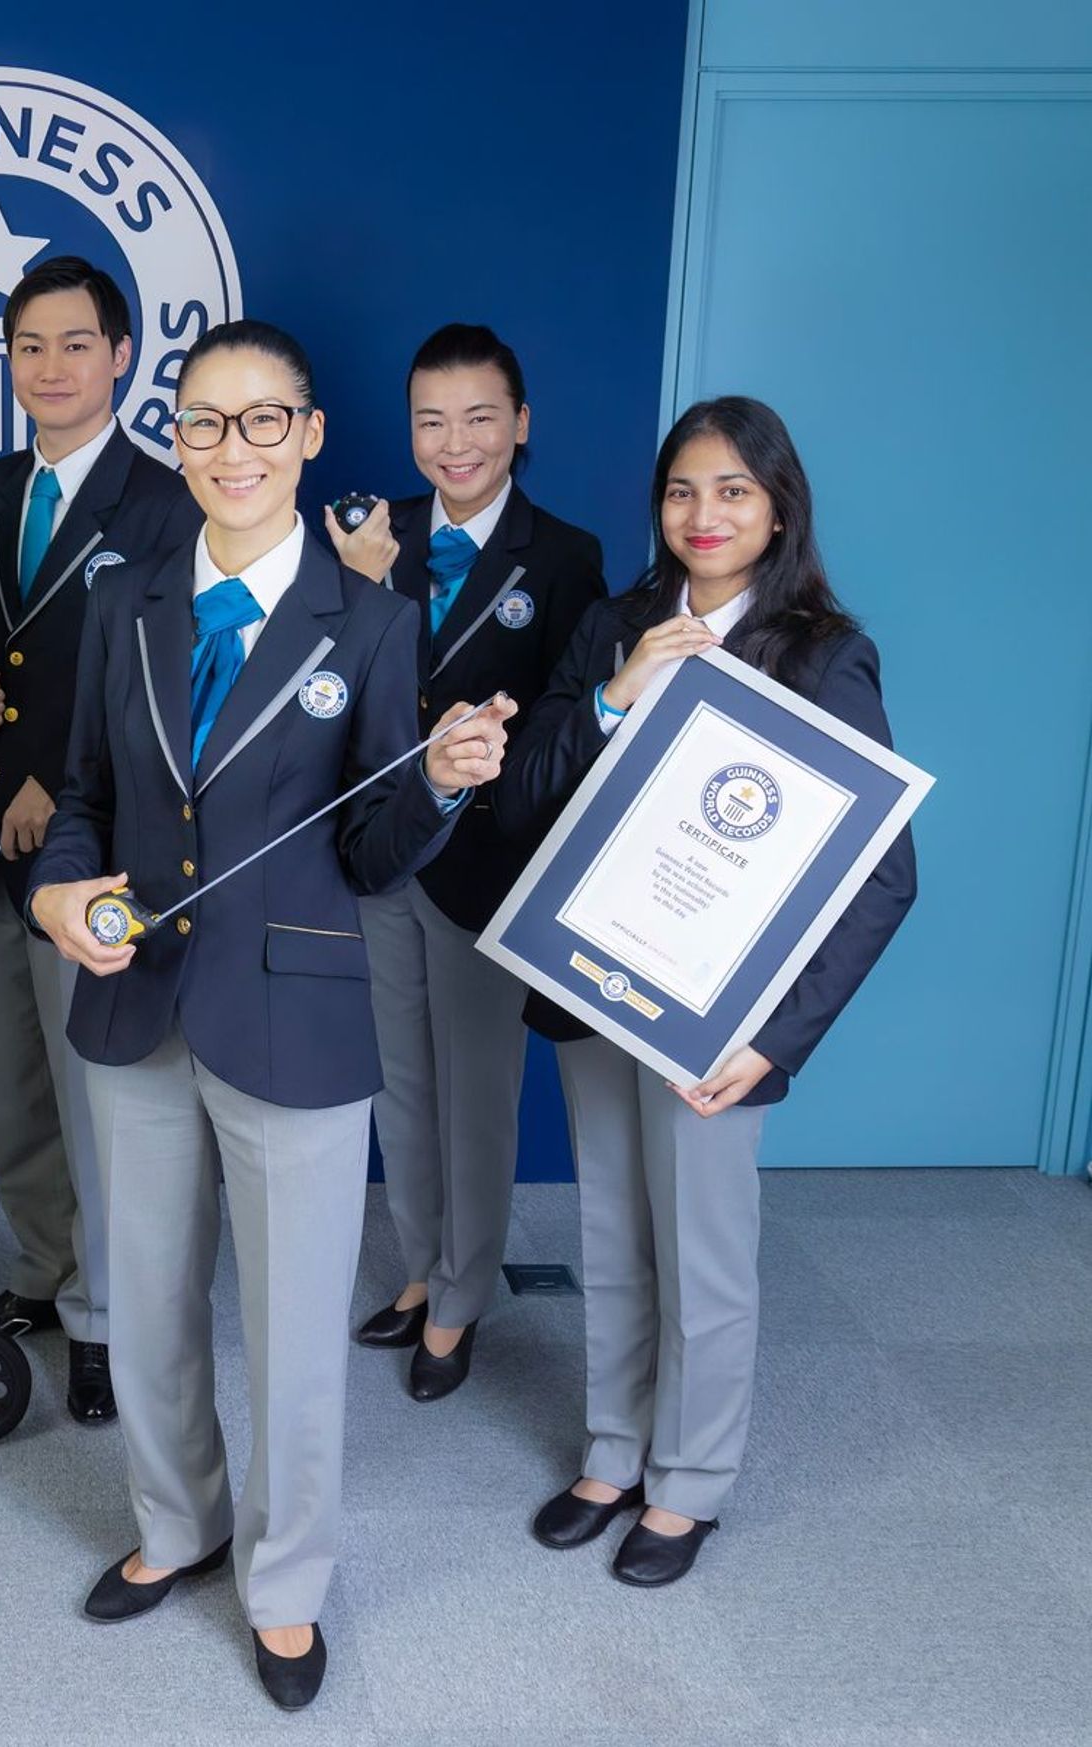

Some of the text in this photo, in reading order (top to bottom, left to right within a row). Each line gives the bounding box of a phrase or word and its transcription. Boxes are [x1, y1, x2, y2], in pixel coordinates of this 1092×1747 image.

[705, 781, 774, 838] WORLD RECORDS
[726, 766, 778, 804] GUINNESS
[677, 818, 749, 868] CERTIFICATE
